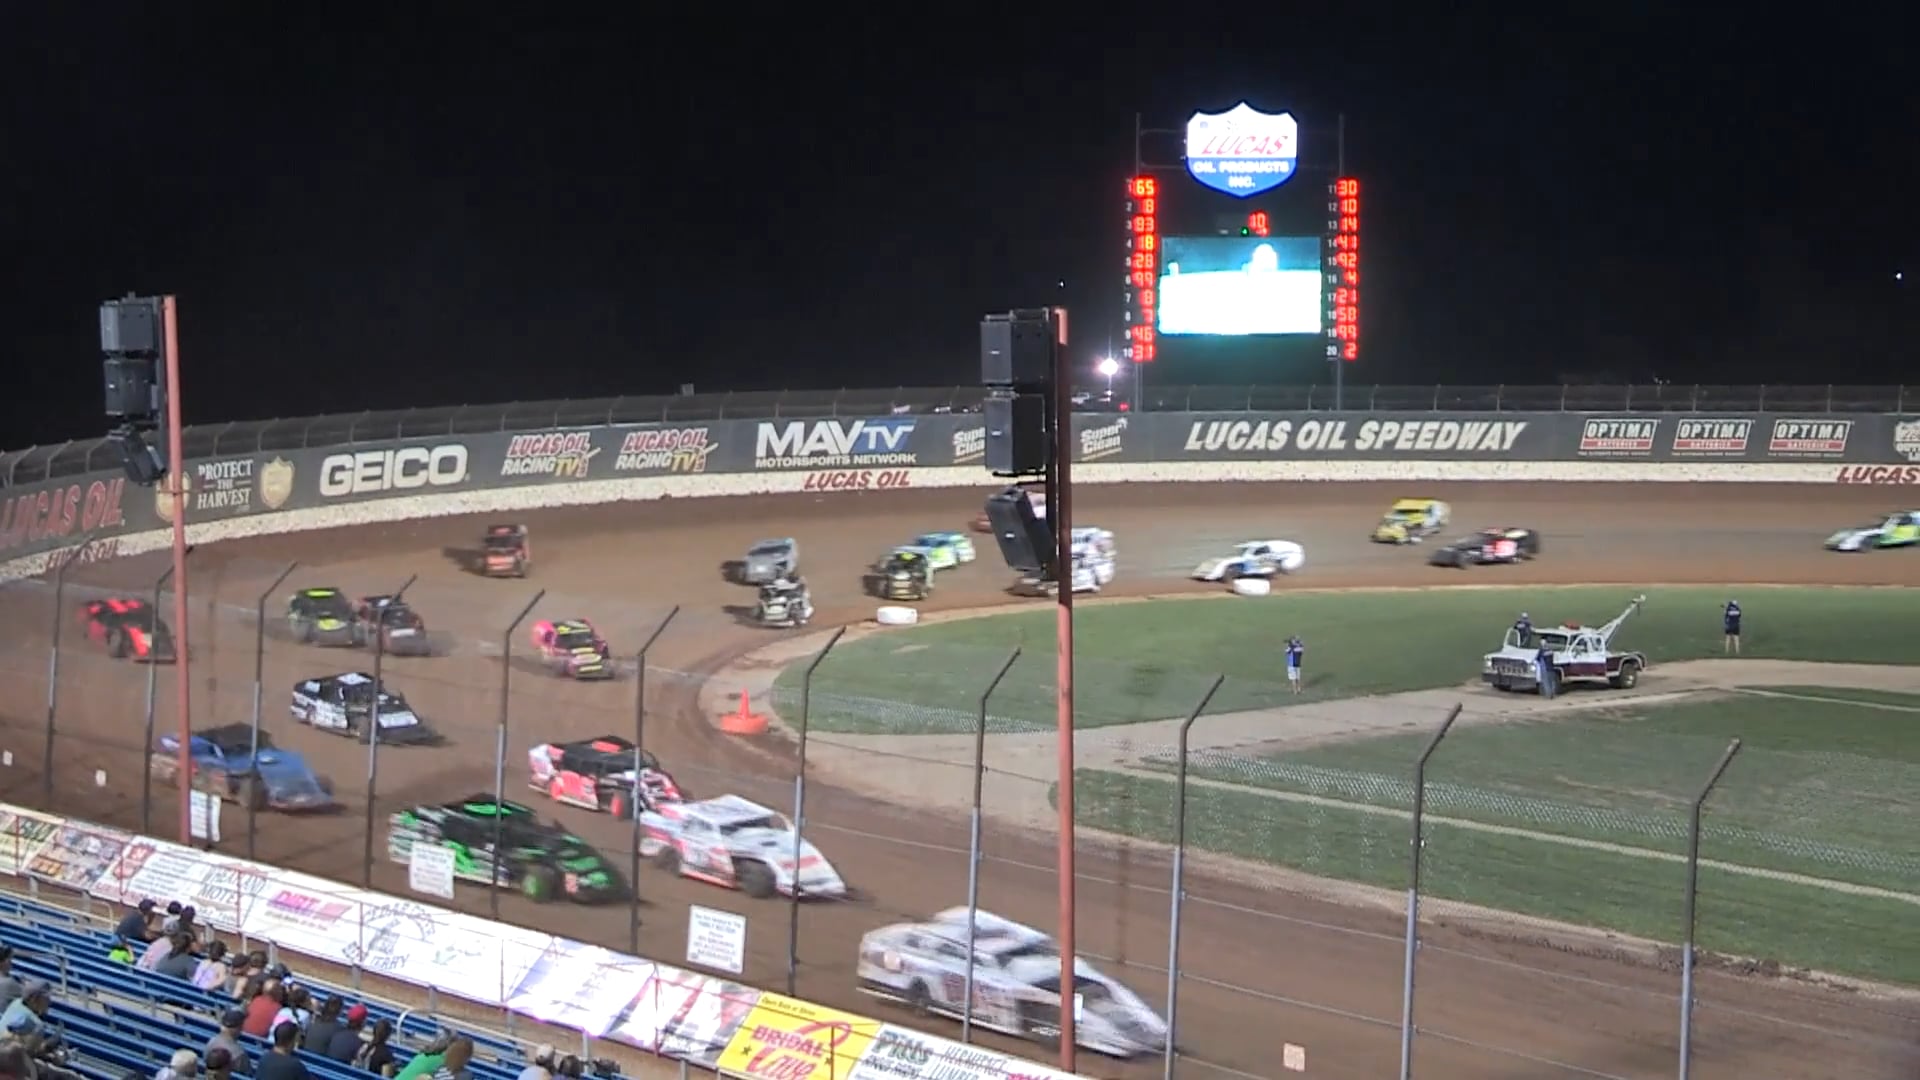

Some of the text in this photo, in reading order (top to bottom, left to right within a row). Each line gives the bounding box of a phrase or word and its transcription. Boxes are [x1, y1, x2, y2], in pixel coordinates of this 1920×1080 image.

[1201, 135, 1288, 155] LUCAS
[1193, 161, 1289, 173] OIL PRODUCTS
[1136, 179, 1154, 195] 65
[1337, 179, 1357, 196] 30
[1145, 198, 1154, 214] 8
[1342, 198, 1357, 214] 10
[1249, 212, 1266, 229] 10
[1139, 235, 1154, 250] 18
[1135, 253, 1153, 268] 28
[1336, 252, 1357, 268] 92
[1135, 271, 1153, 287] 99
[1144, 289, 1153, 305] 8
[1134, 326, 1153, 342] 46
[1336, 324, 1357, 340] 99
[1344, 342, 1357, 359] 2
[953, 427, 986, 444] Supe
[1081, 424, 1122, 443] Super
[1184, 421, 1526, 450] LUCAS OIL SPEEDWAY
[1587, 423, 1650, 438] OPTIMA
[1680, 423, 1745, 438] OPTIMA
[1777, 424, 1844, 439] OPTIMA
[508, 432, 590, 458] LUCAS OIL
[621, 428, 708, 454] LUCAS OIL
[956, 439, 986, 456] Clea
[1083, 436, 1121, 454] Clean
[501, 457, 556, 476] RACING
[615, 452, 672, 471] RACING
[756, 453, 917, 468] MOTORSPORTS NETWORK
[198, 459, 254, 480] PROTECT
[320, 444, 469, 497] GEICO
[1837, 466, 1920, 483] LUCAS
[804, 470, 911, 490] LUCAS OIL
[197, 488, 253, 510] HARVEST
[752, 1024, 825, 1058] BRIDAL
